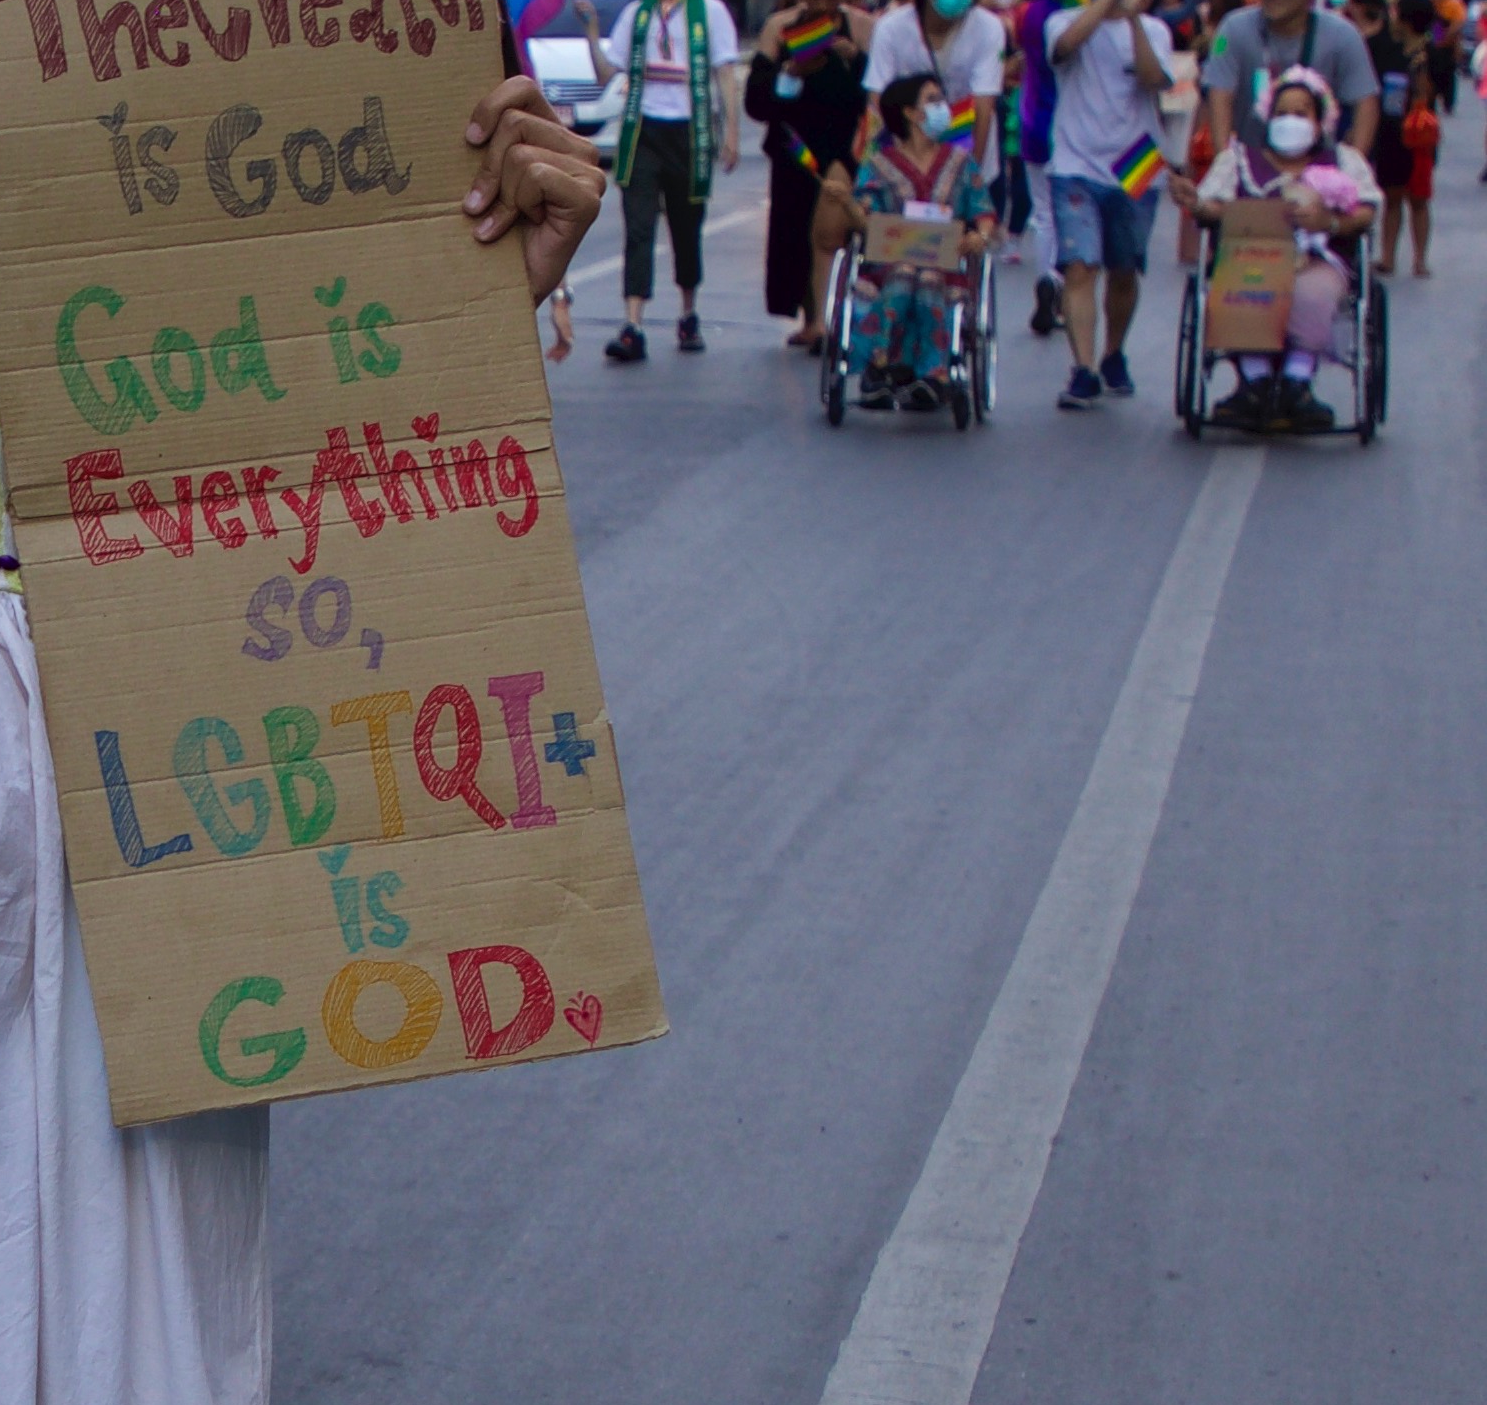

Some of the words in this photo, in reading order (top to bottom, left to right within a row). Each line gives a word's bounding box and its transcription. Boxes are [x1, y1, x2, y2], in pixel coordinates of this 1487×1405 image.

[96, 100, 180, 216] is
[205, 96, 412, 218] God
[54, 285, 287, 436] God
[314, 275, 402, 385] is
[64, 412, 540, 575] Everything
[93, 670, 597, 869] LGBTQI+
[317, 843, 412, 955] is
